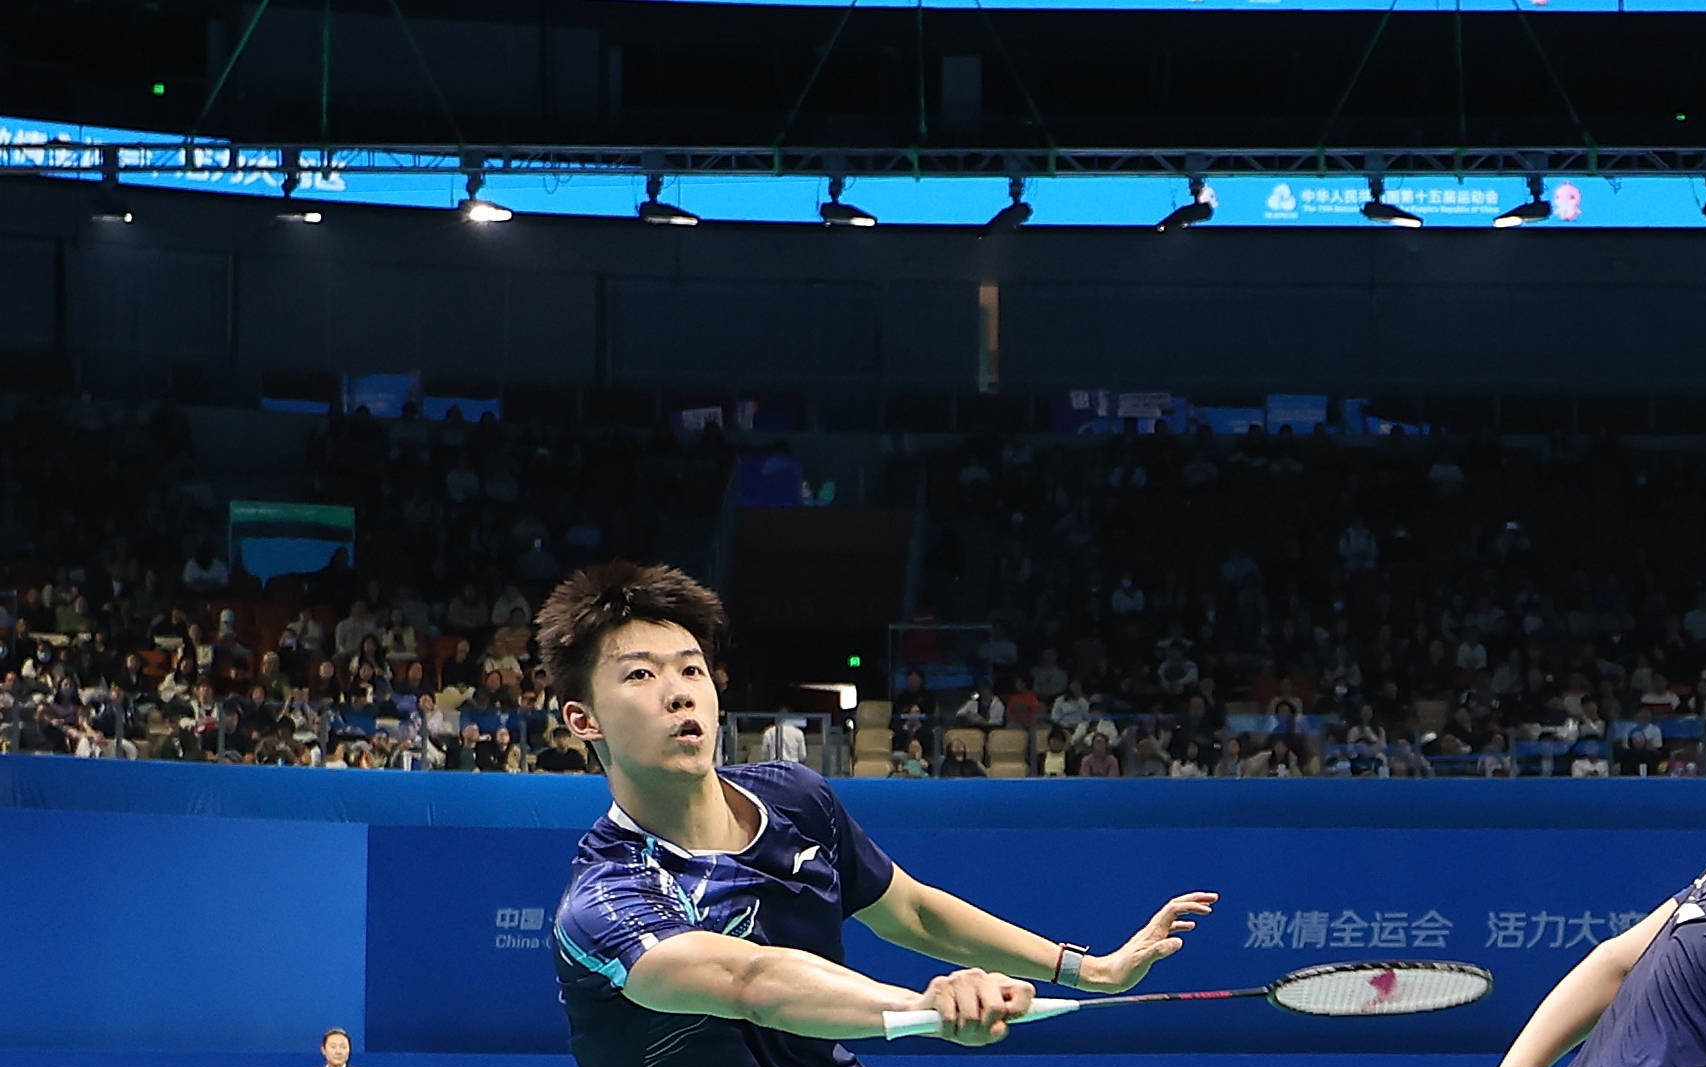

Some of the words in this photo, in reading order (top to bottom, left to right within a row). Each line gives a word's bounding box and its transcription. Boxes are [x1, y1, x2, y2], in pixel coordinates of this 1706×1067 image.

[1243, 909, 1454, 949] 激情全运会
